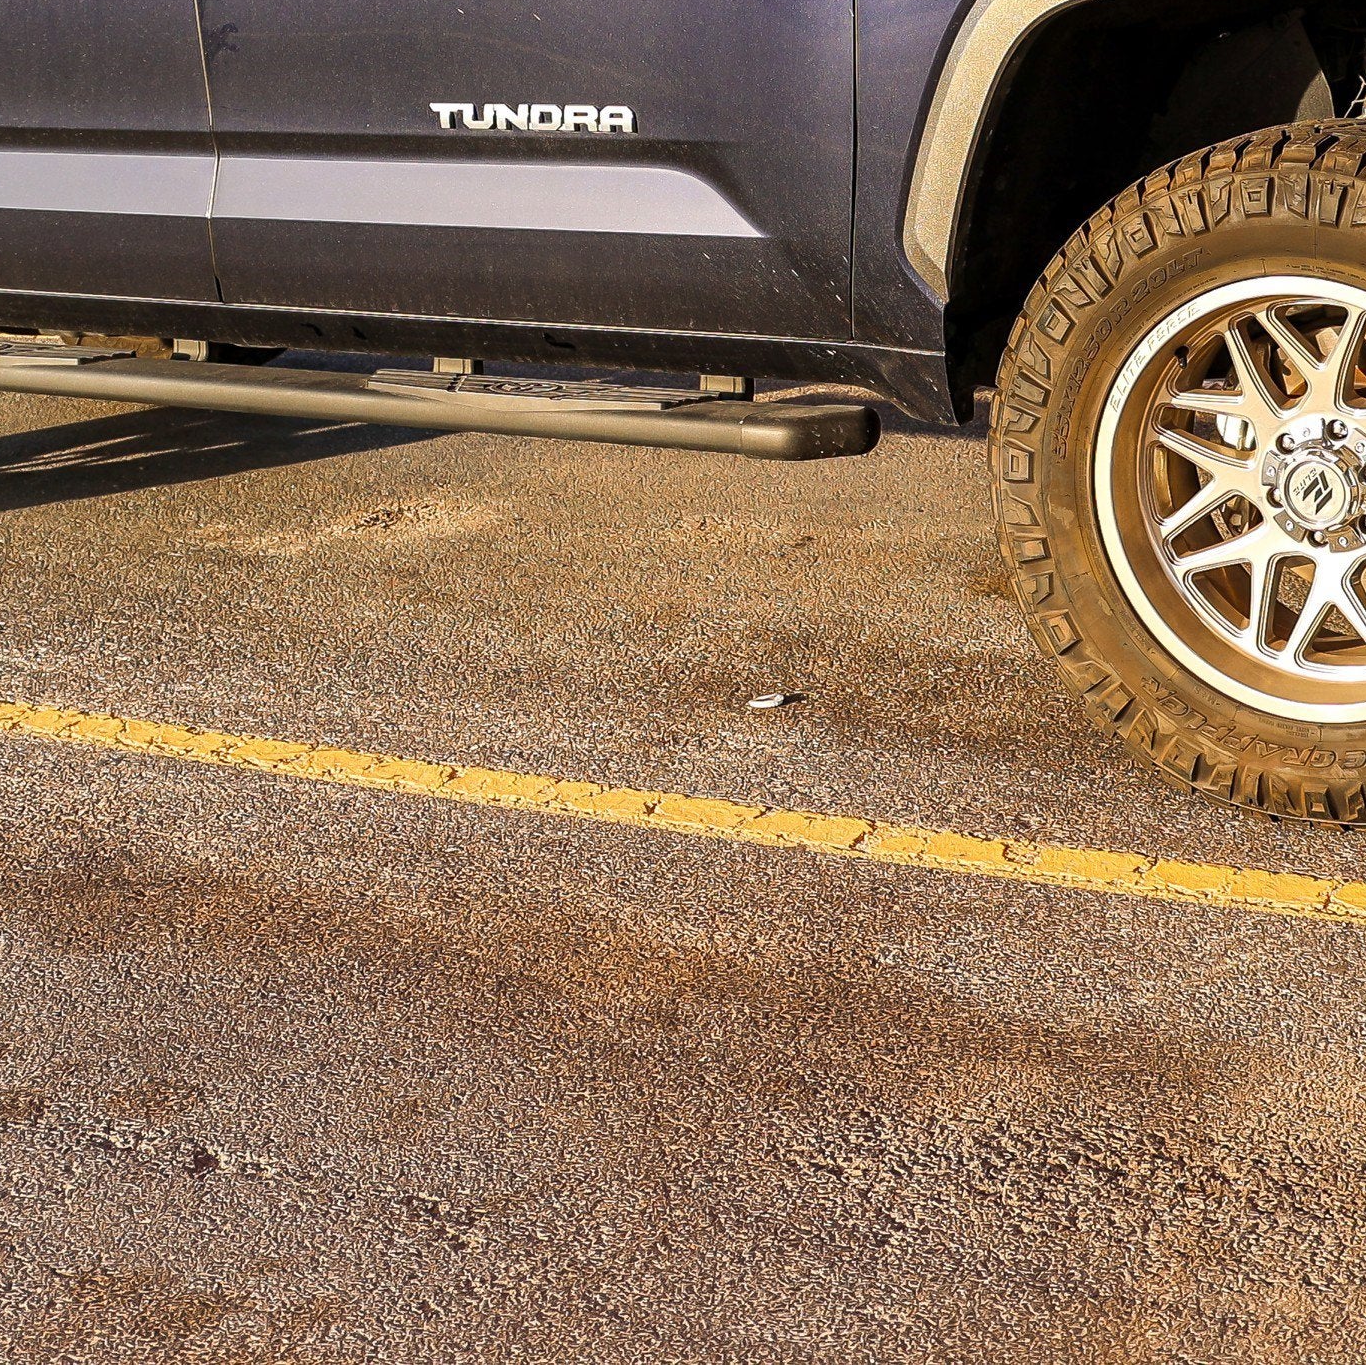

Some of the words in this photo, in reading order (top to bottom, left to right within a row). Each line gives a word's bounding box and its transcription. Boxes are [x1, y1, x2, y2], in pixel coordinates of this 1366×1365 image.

[429, 102, 637, 134] TUNDRA
[1109, 352, 1150, 413] ELITE
[1293, 468, 1317, 496] ELITE
[1142, 676, 1337, 769] GRAPPLER
